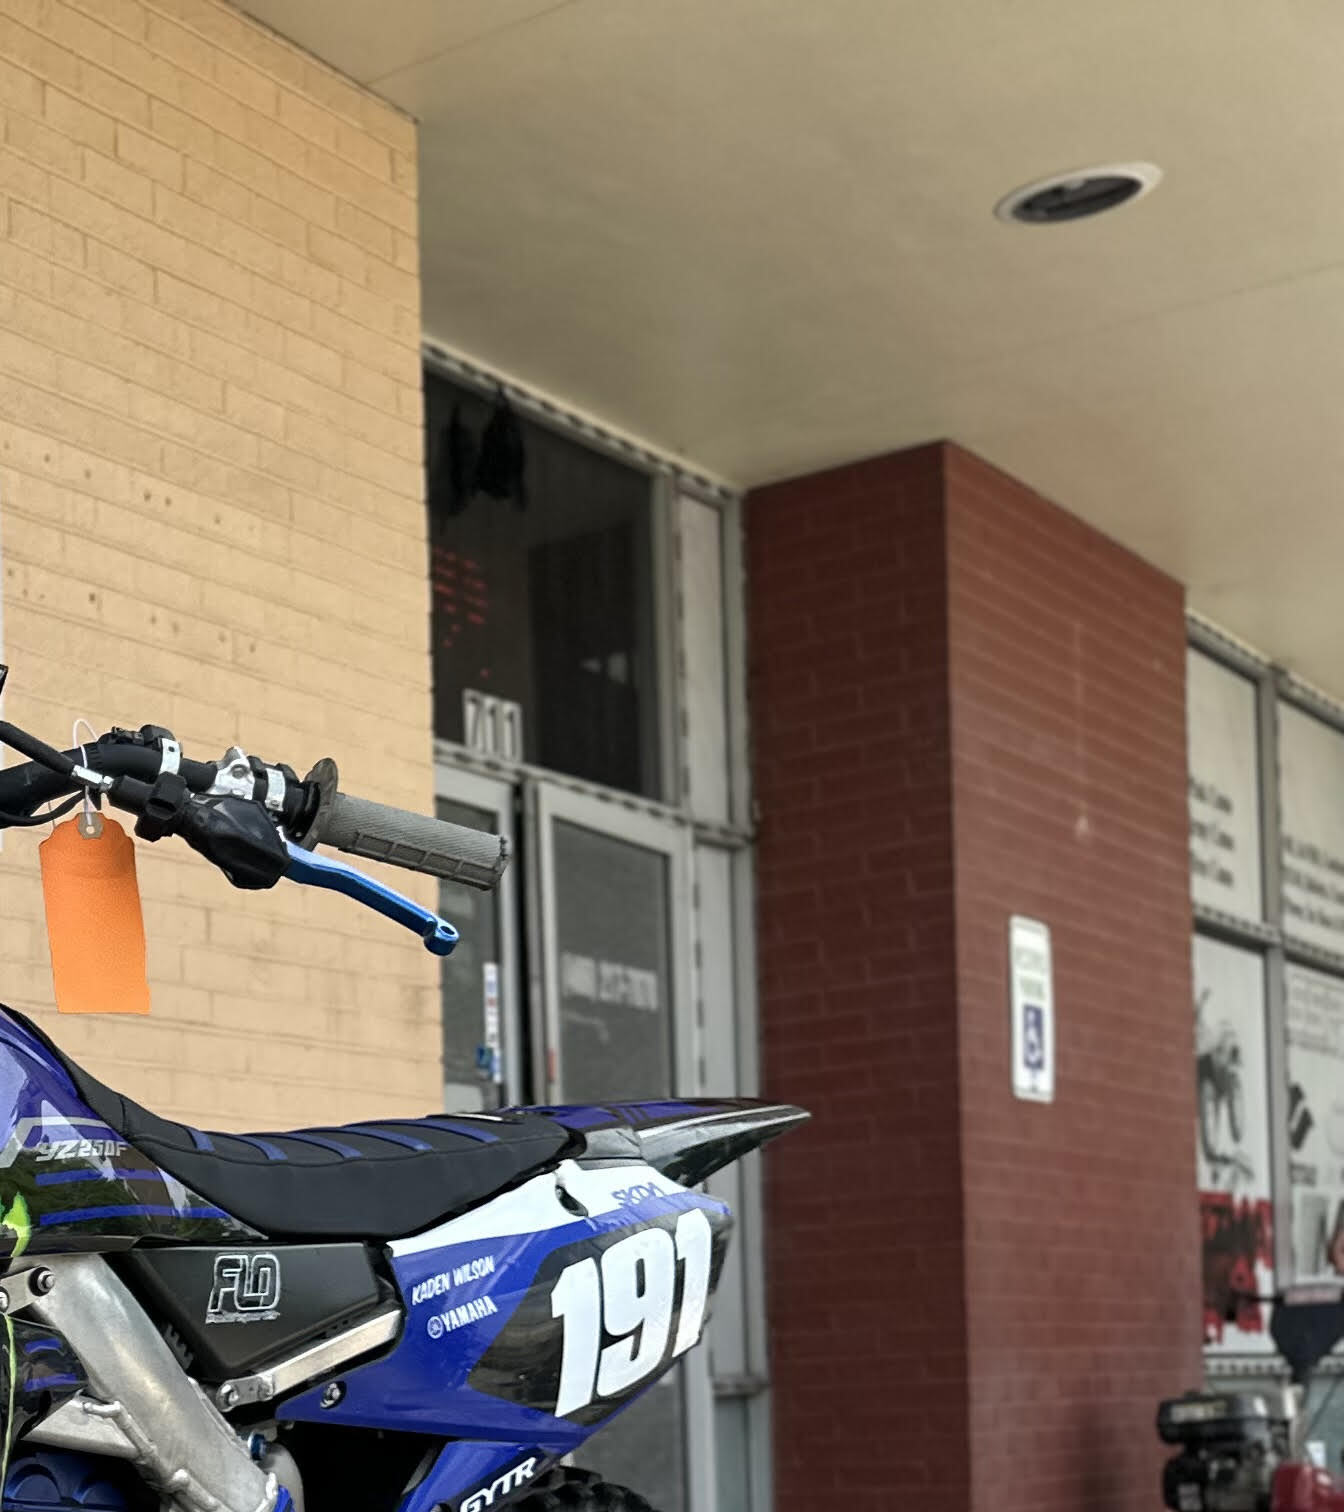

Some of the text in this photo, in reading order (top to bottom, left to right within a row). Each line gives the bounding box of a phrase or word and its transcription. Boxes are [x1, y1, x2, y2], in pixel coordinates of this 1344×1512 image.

[412, 1255, 496, 1306] KADEN WILSON
[441, 1296, 498, 1332] YAMAHA
[550, 1207, 713, 1418] 191
